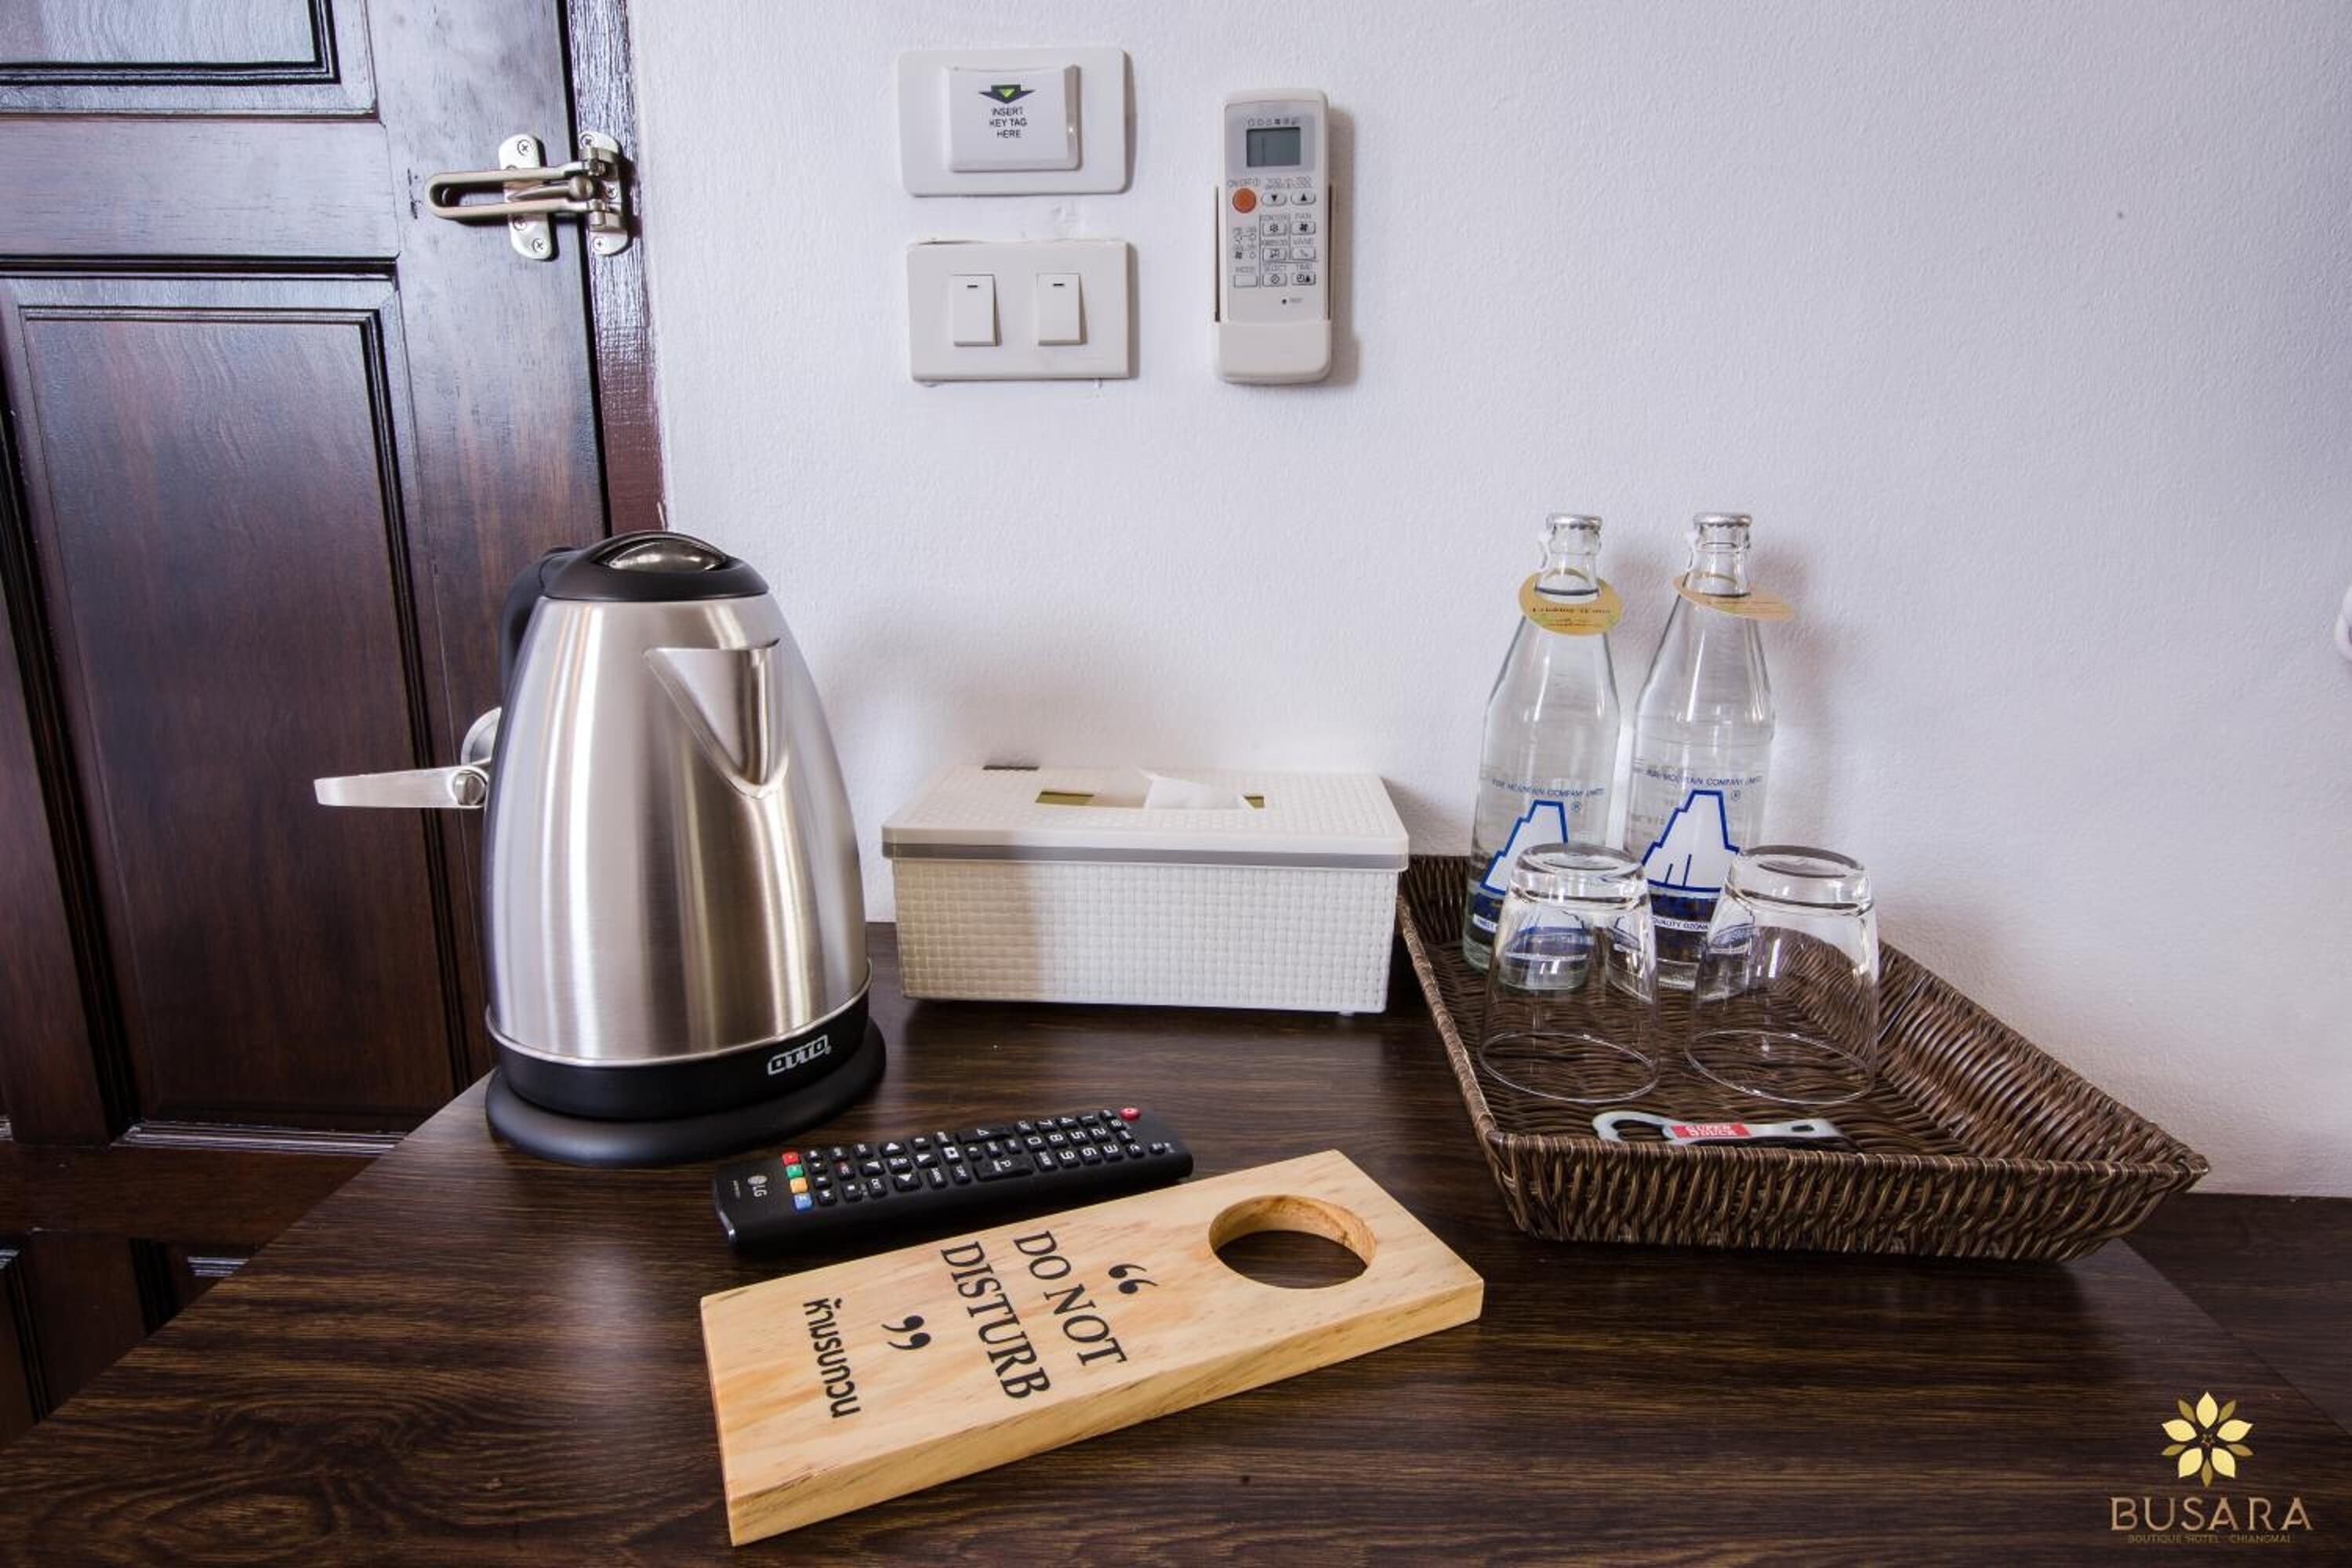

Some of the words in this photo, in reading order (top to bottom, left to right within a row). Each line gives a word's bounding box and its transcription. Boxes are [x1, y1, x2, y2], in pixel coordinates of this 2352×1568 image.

[990, 107, 1023, 116] INSERT
[989, 118, 1007, 128] KEY
[1009, 117, 1028, 127] TAG
[996, 129, 1022, 138] HERE
[767, 1034, 828, 1076] OTTO
[1070, 1131, 1085, 1140] 5
[1082, 1147, 1097, 1156] 6
[1104, 1145, 1119, 1153] 3
[1059, 1150, 1075, 1160] 9
[753, 1185, 767, 1197] LG
[1013, 1230, 1071, 1279] DO
[1043, 1283, 1127, 1367] NOT
[940, 1241, 1051, 1399] DISTURB
[802, 1298, 862, 1418] ห้ามรบกวน
